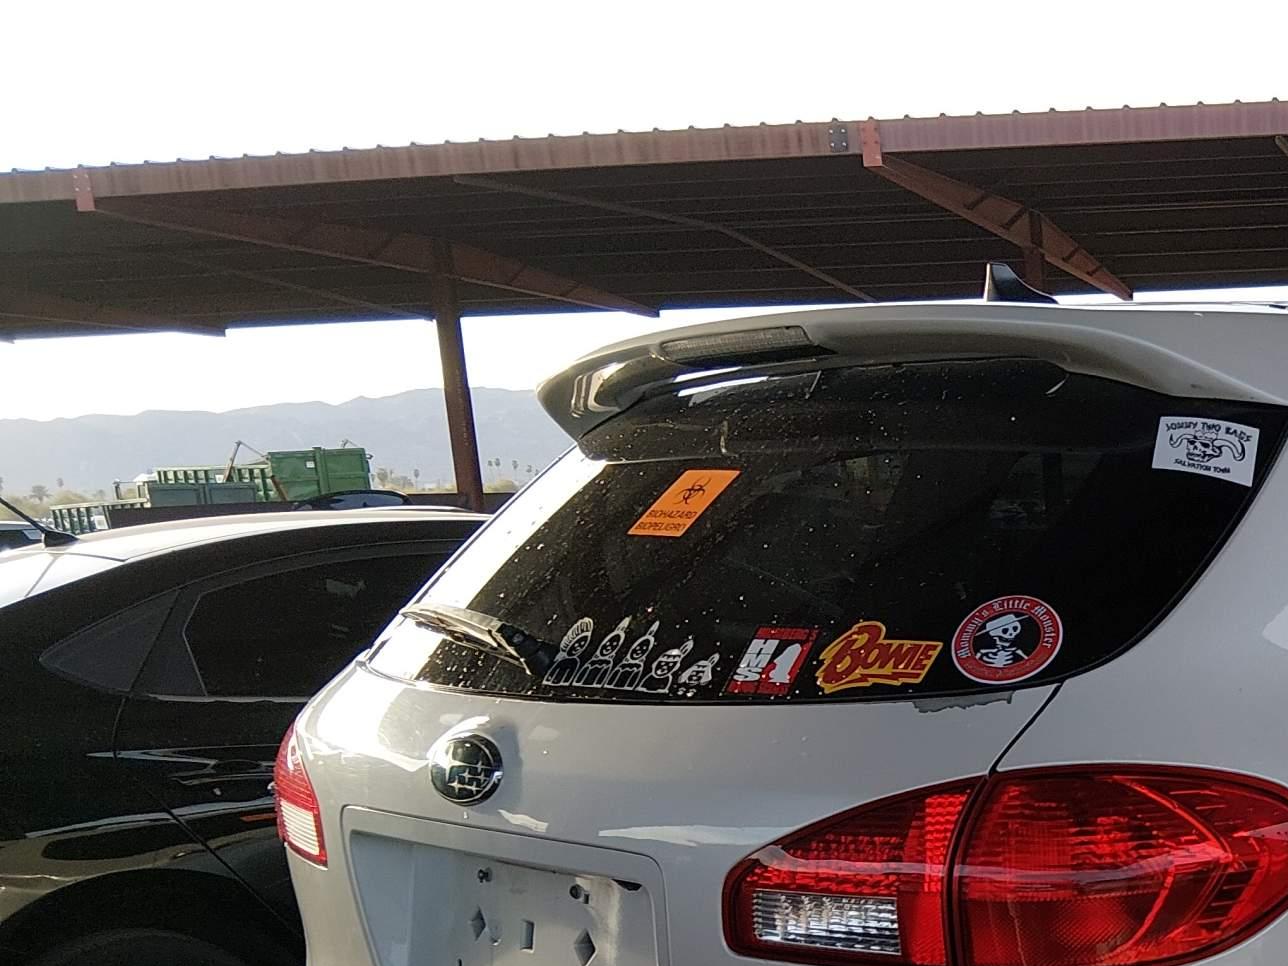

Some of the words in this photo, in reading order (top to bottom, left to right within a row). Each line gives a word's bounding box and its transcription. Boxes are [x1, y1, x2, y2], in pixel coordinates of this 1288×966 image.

[1201, 422, 1222, 432] TWO
[1225, 427, 1253, 442] BAGS
[1173, 458, 1211, 471] SALVATION
[1212, 466, 1231, 474] TOWN
[646, 509, 698, 520] BIOHAZARD
[635, 521, 687, 532] BIOPELIGRO
[992, 599, 1031, 612] Little
[1031, 604, 1056, 649] Monster
